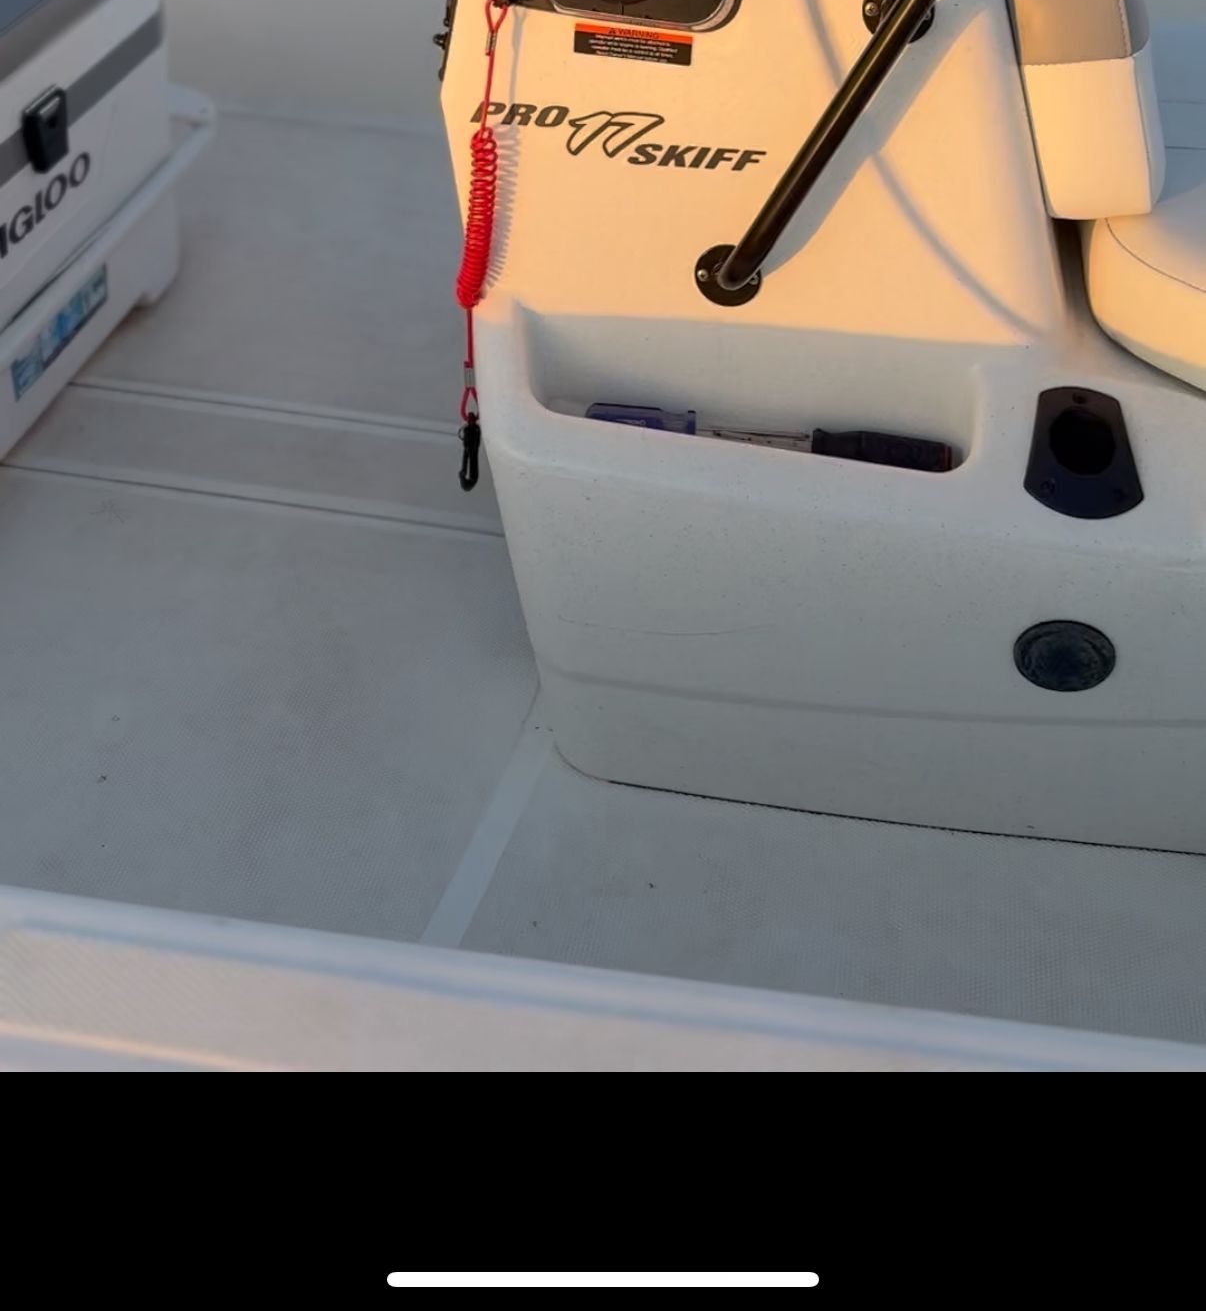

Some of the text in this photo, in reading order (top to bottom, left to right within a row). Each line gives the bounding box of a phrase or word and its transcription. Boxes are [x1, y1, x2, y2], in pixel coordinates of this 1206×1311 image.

[469, 101, 767, 171] PRO 17 SKIFF
